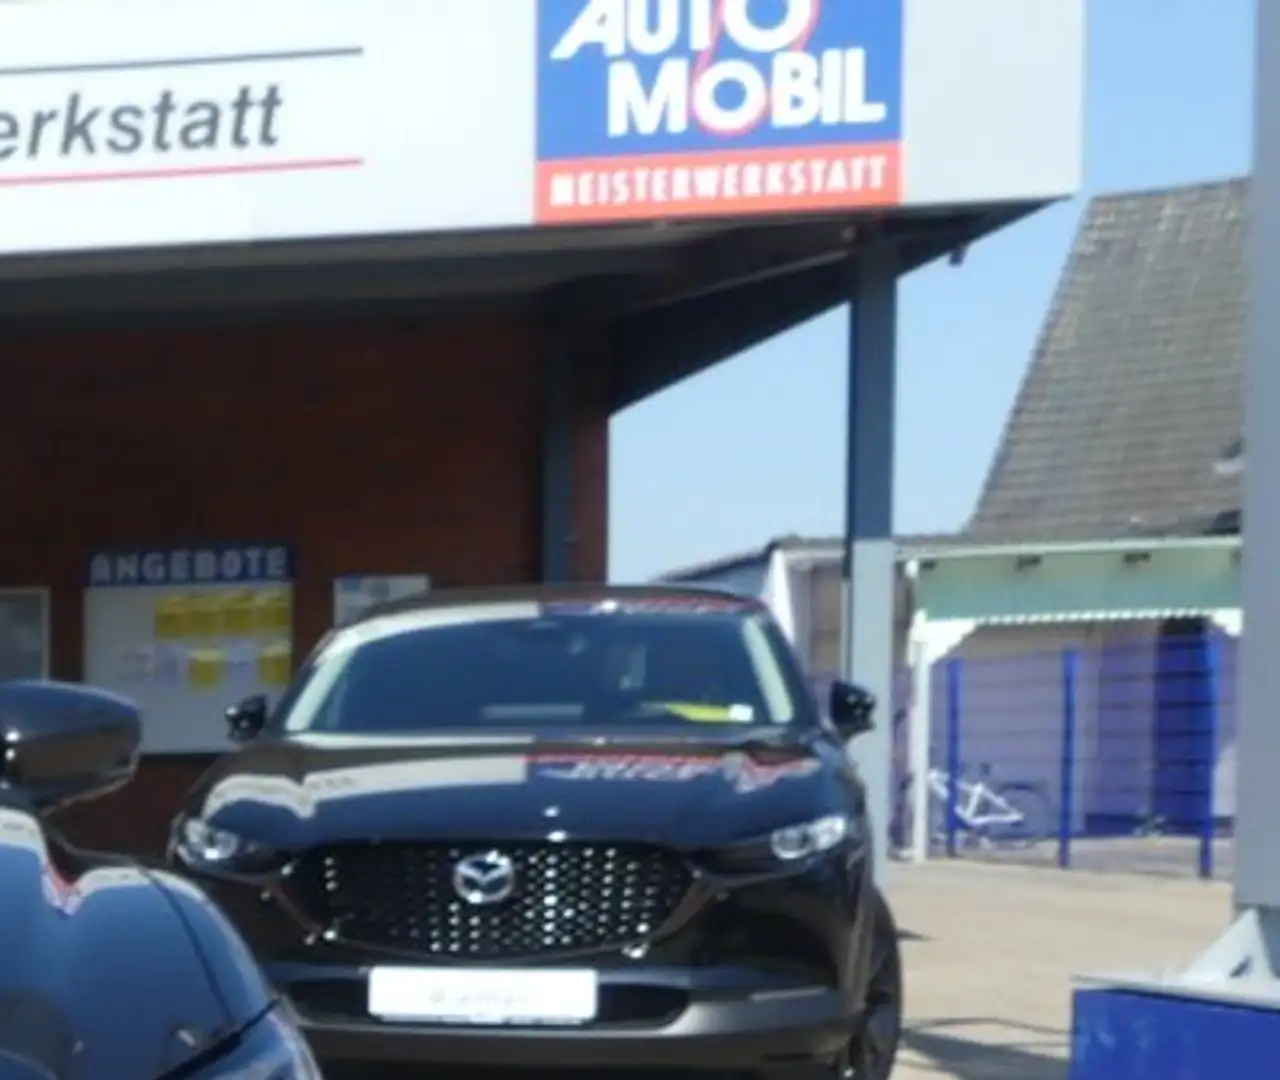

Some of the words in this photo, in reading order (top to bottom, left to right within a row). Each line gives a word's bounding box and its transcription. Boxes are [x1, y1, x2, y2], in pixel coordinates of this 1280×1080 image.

[607, 47, 887, 138] MOBIL
[549, 155, 887, 207] MEISTERWERKSTATT
[90, 548, 285, 583] ANGEBOTE
